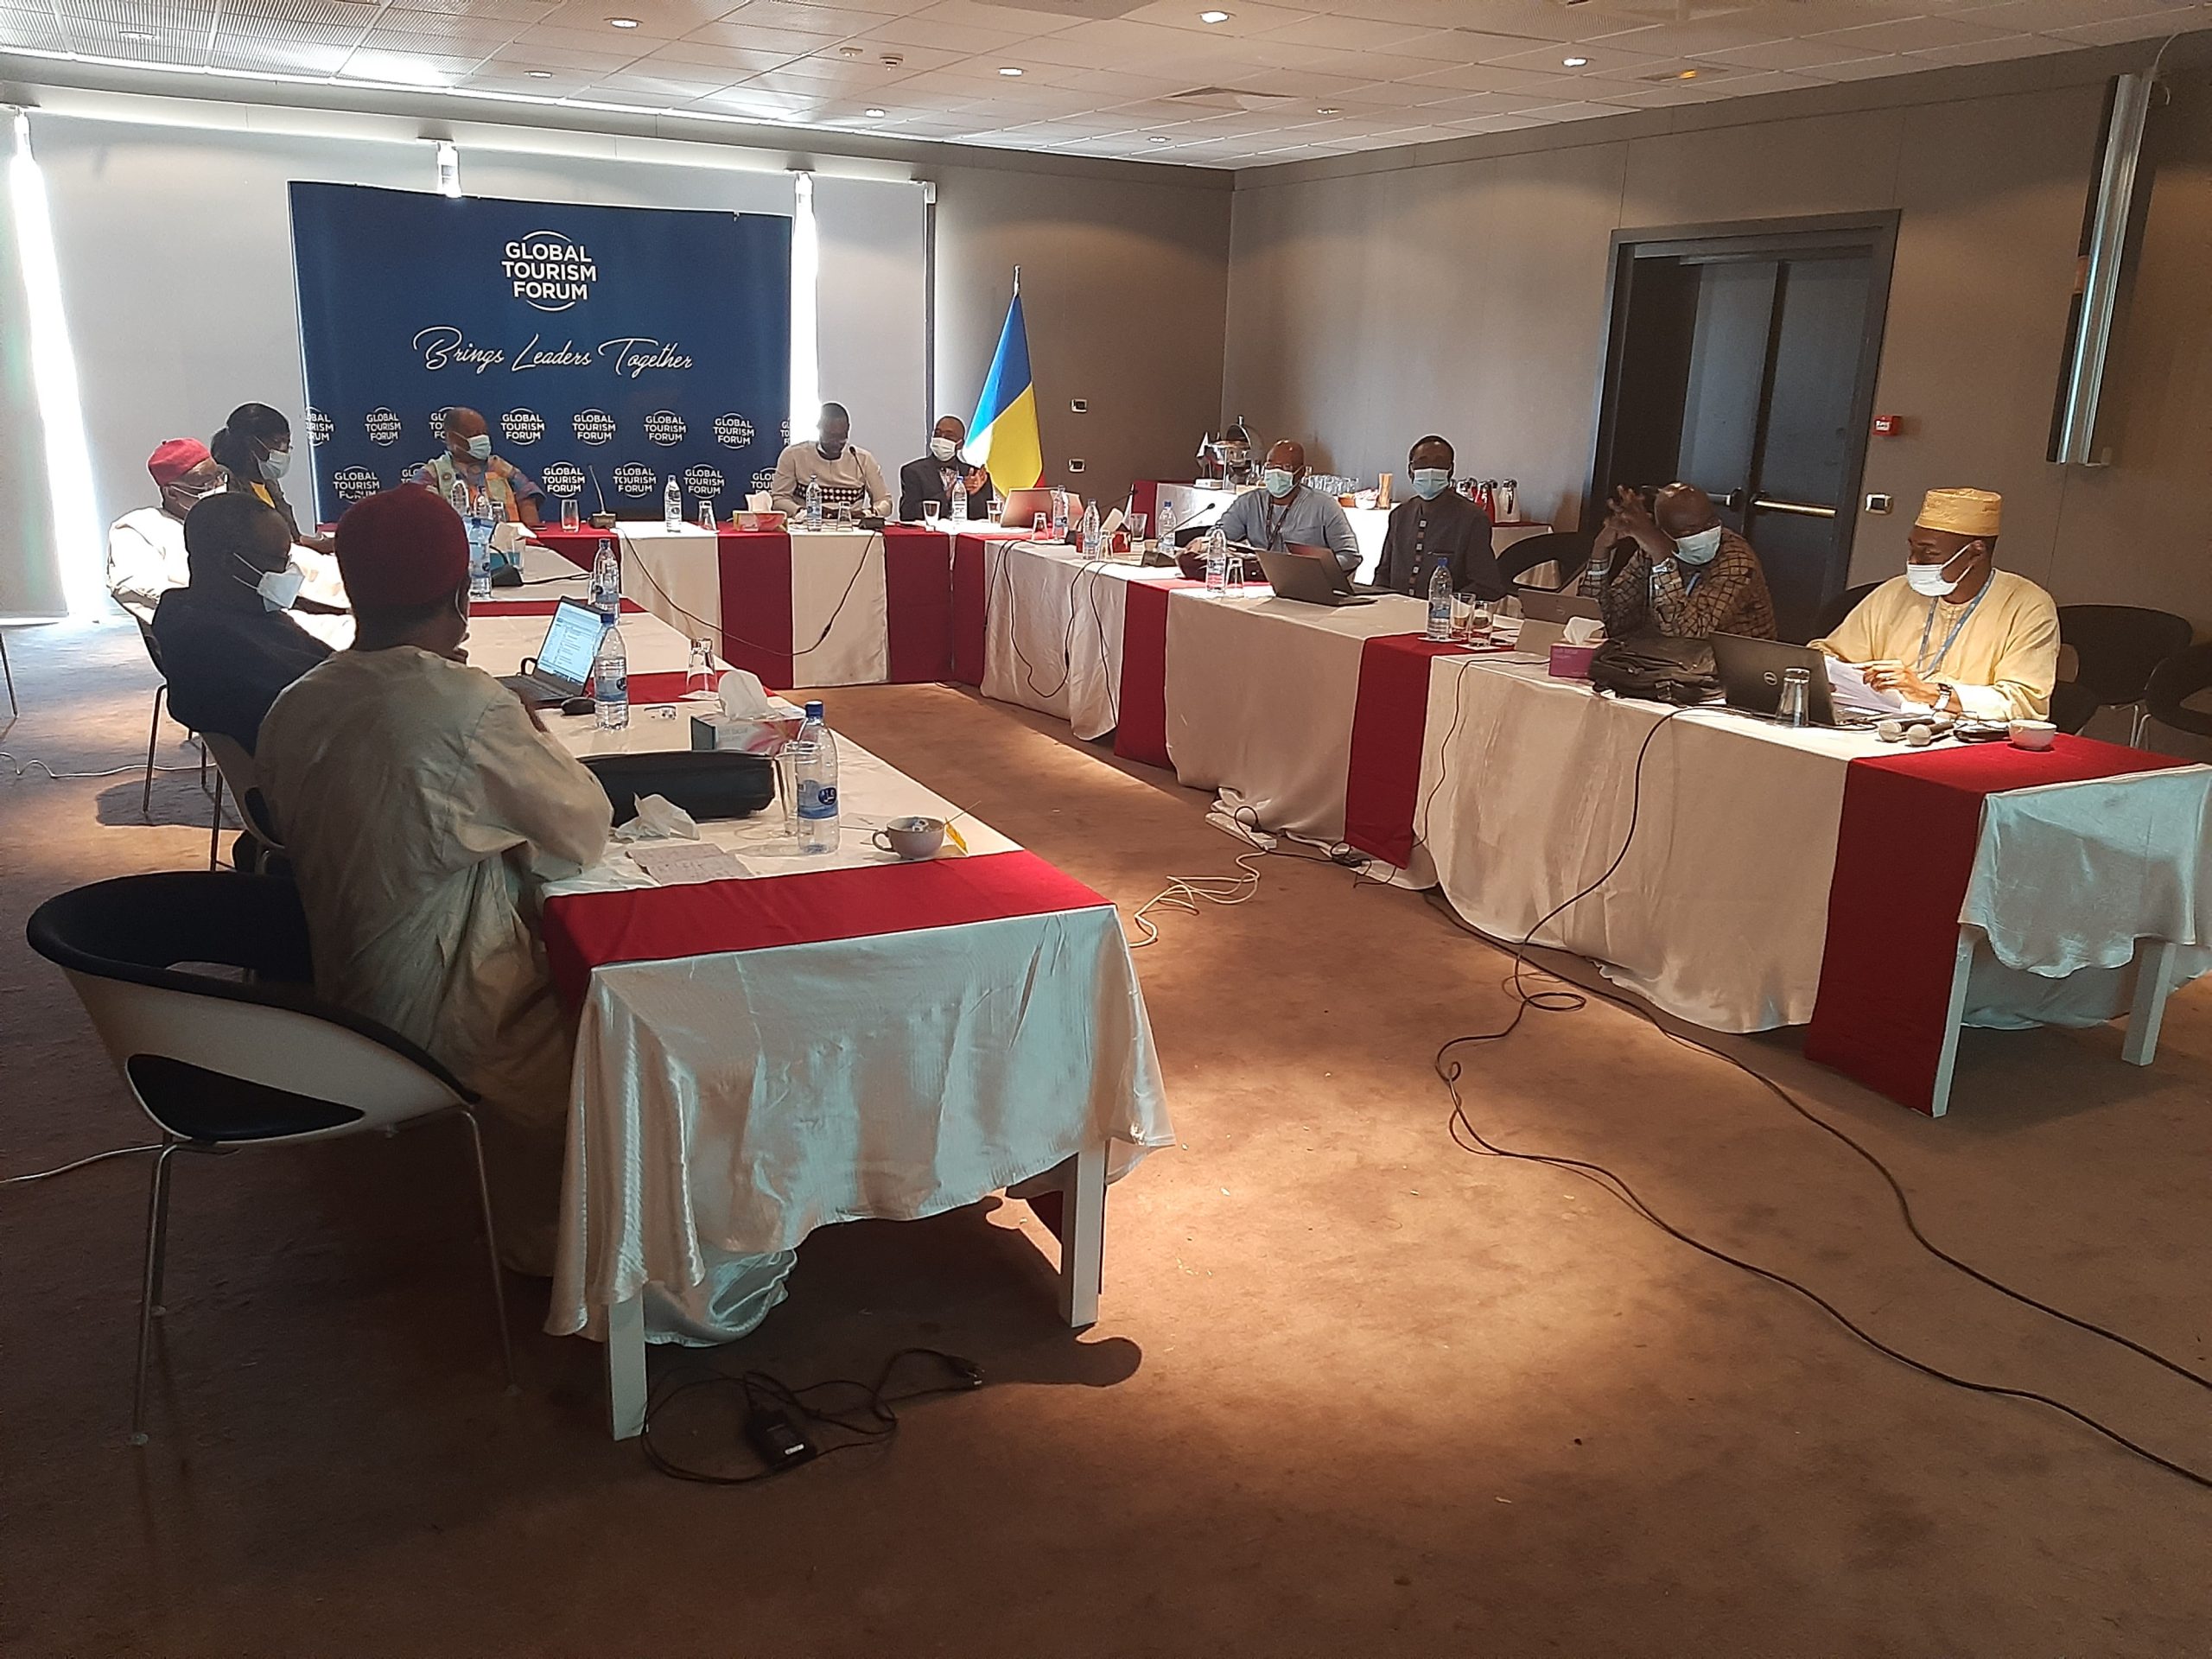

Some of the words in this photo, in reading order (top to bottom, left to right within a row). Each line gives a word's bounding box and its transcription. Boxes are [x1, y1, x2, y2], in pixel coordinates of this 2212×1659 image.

[505, 241, 593, 263] GLOBAL
[501, 260, 597, 282] TOURISM
[513, 281, 588, 301] FORUM
[413, 326, 505, 374] Brings
[512, 334, 592, 372] Leaders
[598, 338, 693, 378] Together
[366, 412, 399, 423] GLOBAL
[502, 414, 543, 423] GLOBAL
[574, 414, 614, 423] GLOBAL
[645, 416, 684, 425] GLOBAL
[365, 422, 402, 432] TOURISM
[500, 422, 545, 431] TOURISM
[572, 423, 616, 432] TOURISM
[644, 423, 687, 433] TOURISM
[715, 417, 753, 429] GLOBAL
[370, 431, 398, 442] FORUM
[505, 431, 541, 440] FORUM
[577, 431, 613, 441] FORUM
[713, 426, 755, 437] TOURISM
[649, 432, 683, 442] FORUM
[717, 435, 751, 445] FORUM
[334, 472, 378, 480] GLOBAL
[543, 467, 583, 475] GLOBAL
[614, 467, 654, 476] GLOBAL
[684, 468, 722, 479] GLOBAL
[333, 480, 380, 490] TOURISM
[542, 475, 586, 485] TOURISM
[613, 475, 657, 485] TOURISM
[683, 477, 725, 486] TOURISM
[547, 484, 582, 493] FORUM
[618, 484, 652, 493] FORUM
[688, 485, 721, 494] FORUM
